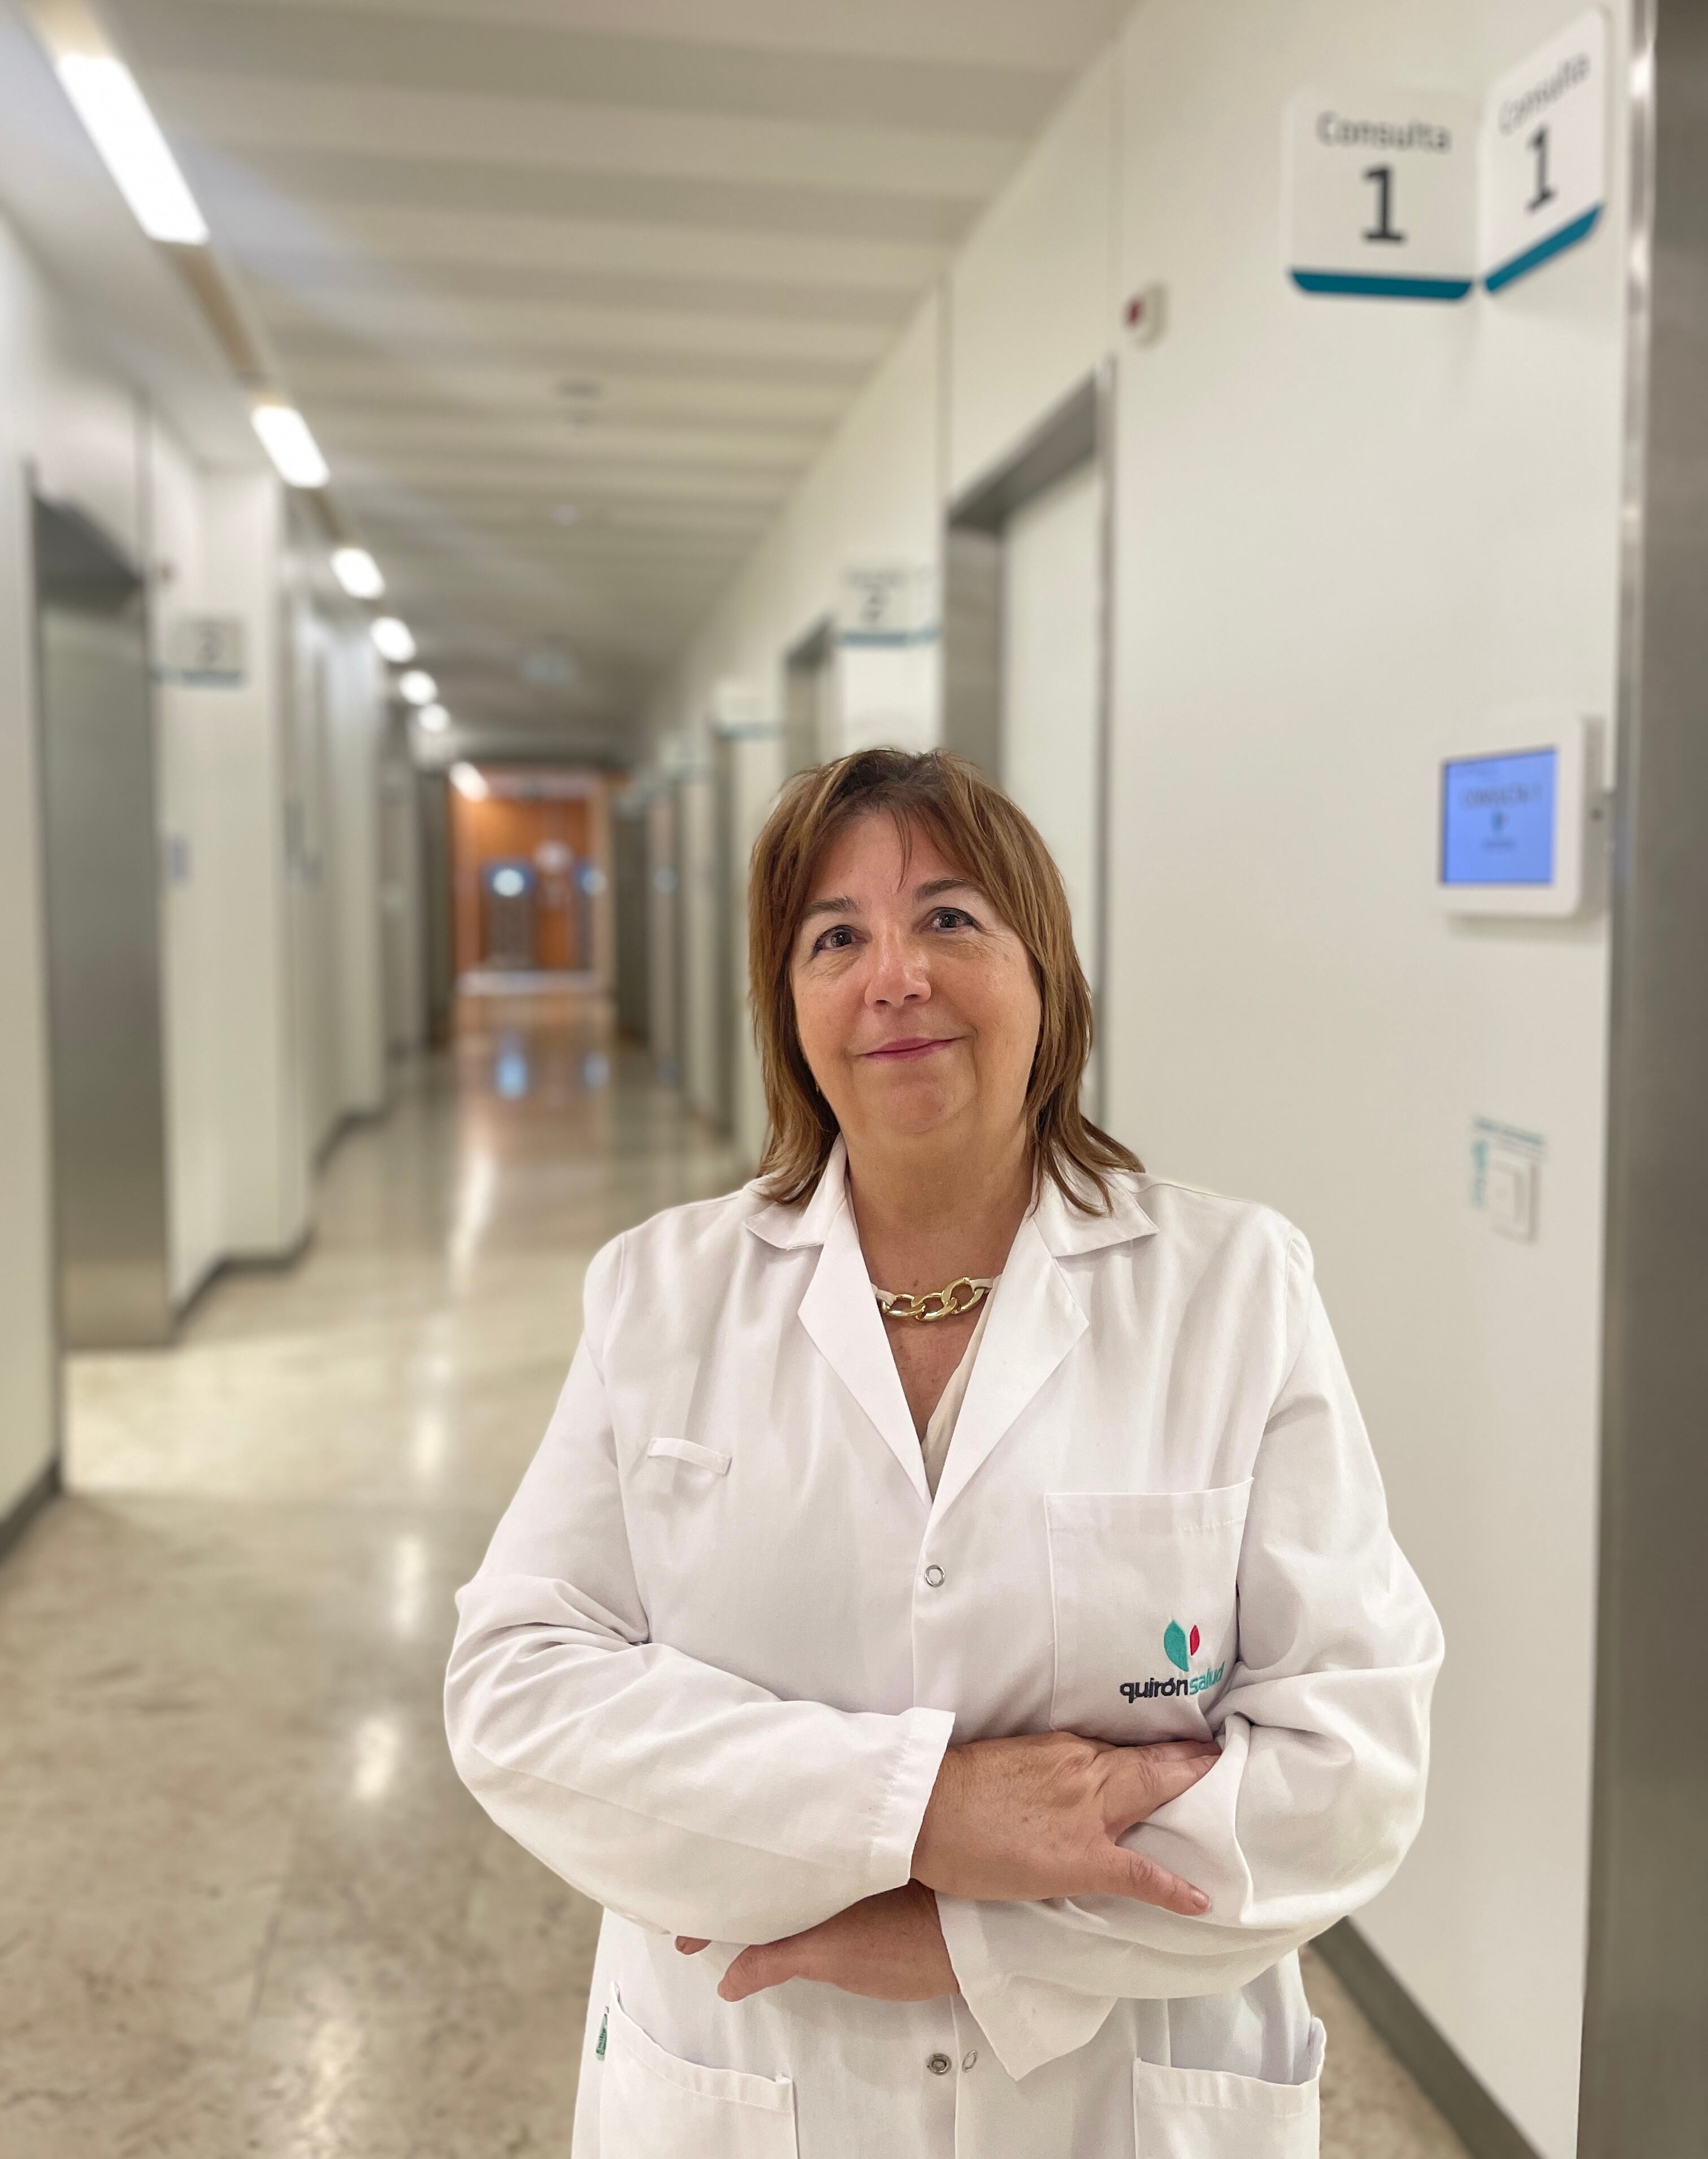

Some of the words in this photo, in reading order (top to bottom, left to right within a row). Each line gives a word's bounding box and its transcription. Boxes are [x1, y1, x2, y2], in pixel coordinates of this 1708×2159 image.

[1316, 110, 1453, 154] Consulta
[1499, 54, 1590, 135] Consulta
[1363, 164, 1406, 245] 1
[1526, 124, 1556, 213] 1
[1120, 1661, 1225, 1704] quirónsalud
